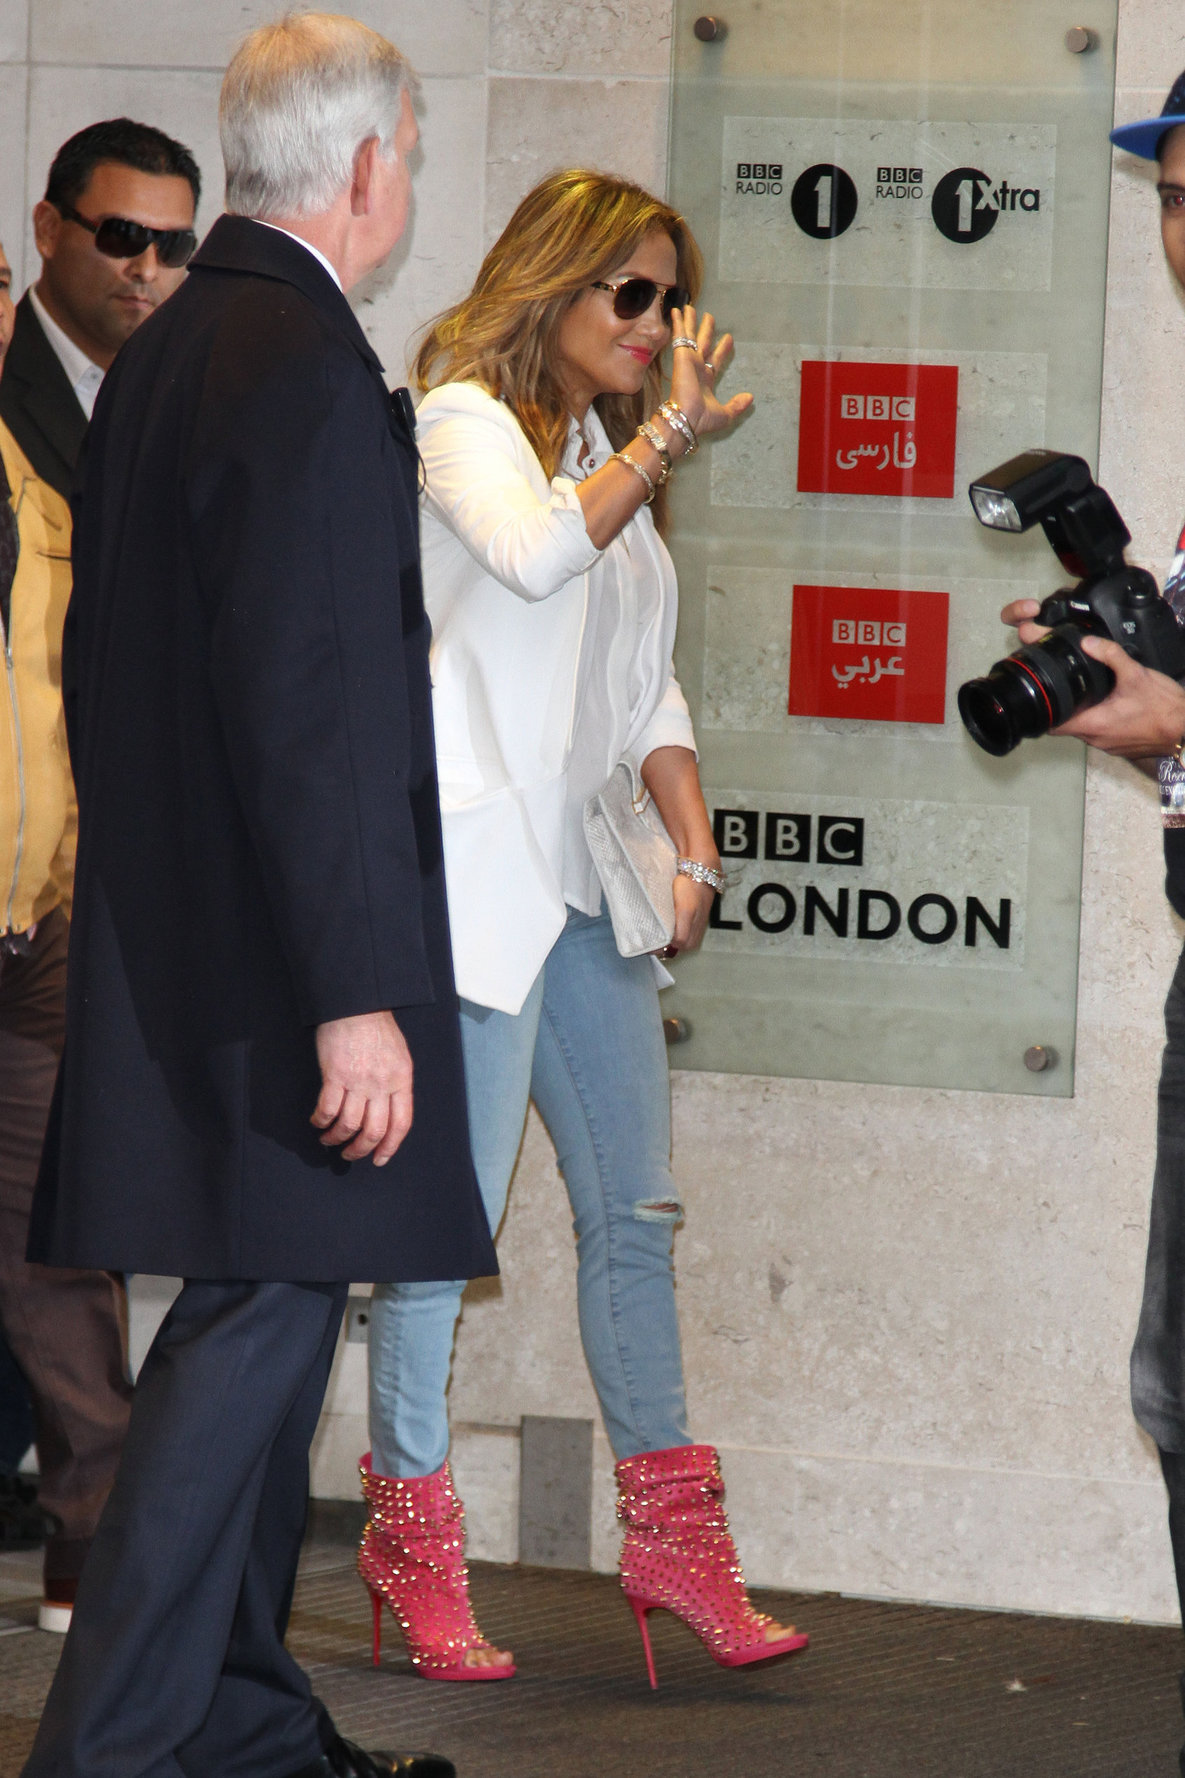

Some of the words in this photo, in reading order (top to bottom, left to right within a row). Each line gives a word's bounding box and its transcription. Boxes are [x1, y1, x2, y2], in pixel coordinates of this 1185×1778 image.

[737, 164, 783, 179] BBC
[877, 167, 923, 183] BBC
[736, 181, 783, 195] RADIO
[814, 175, 833, 228] 1
[876, 185, 923, 199] RADIO
[841, 395, 916, 421] BBC
[832, 619, 907, 647] BBC
[831, 656, 905, 689] عربي
[715, 810, 863, 865] BBC
[710, 882, 1011, 949] LONDON
